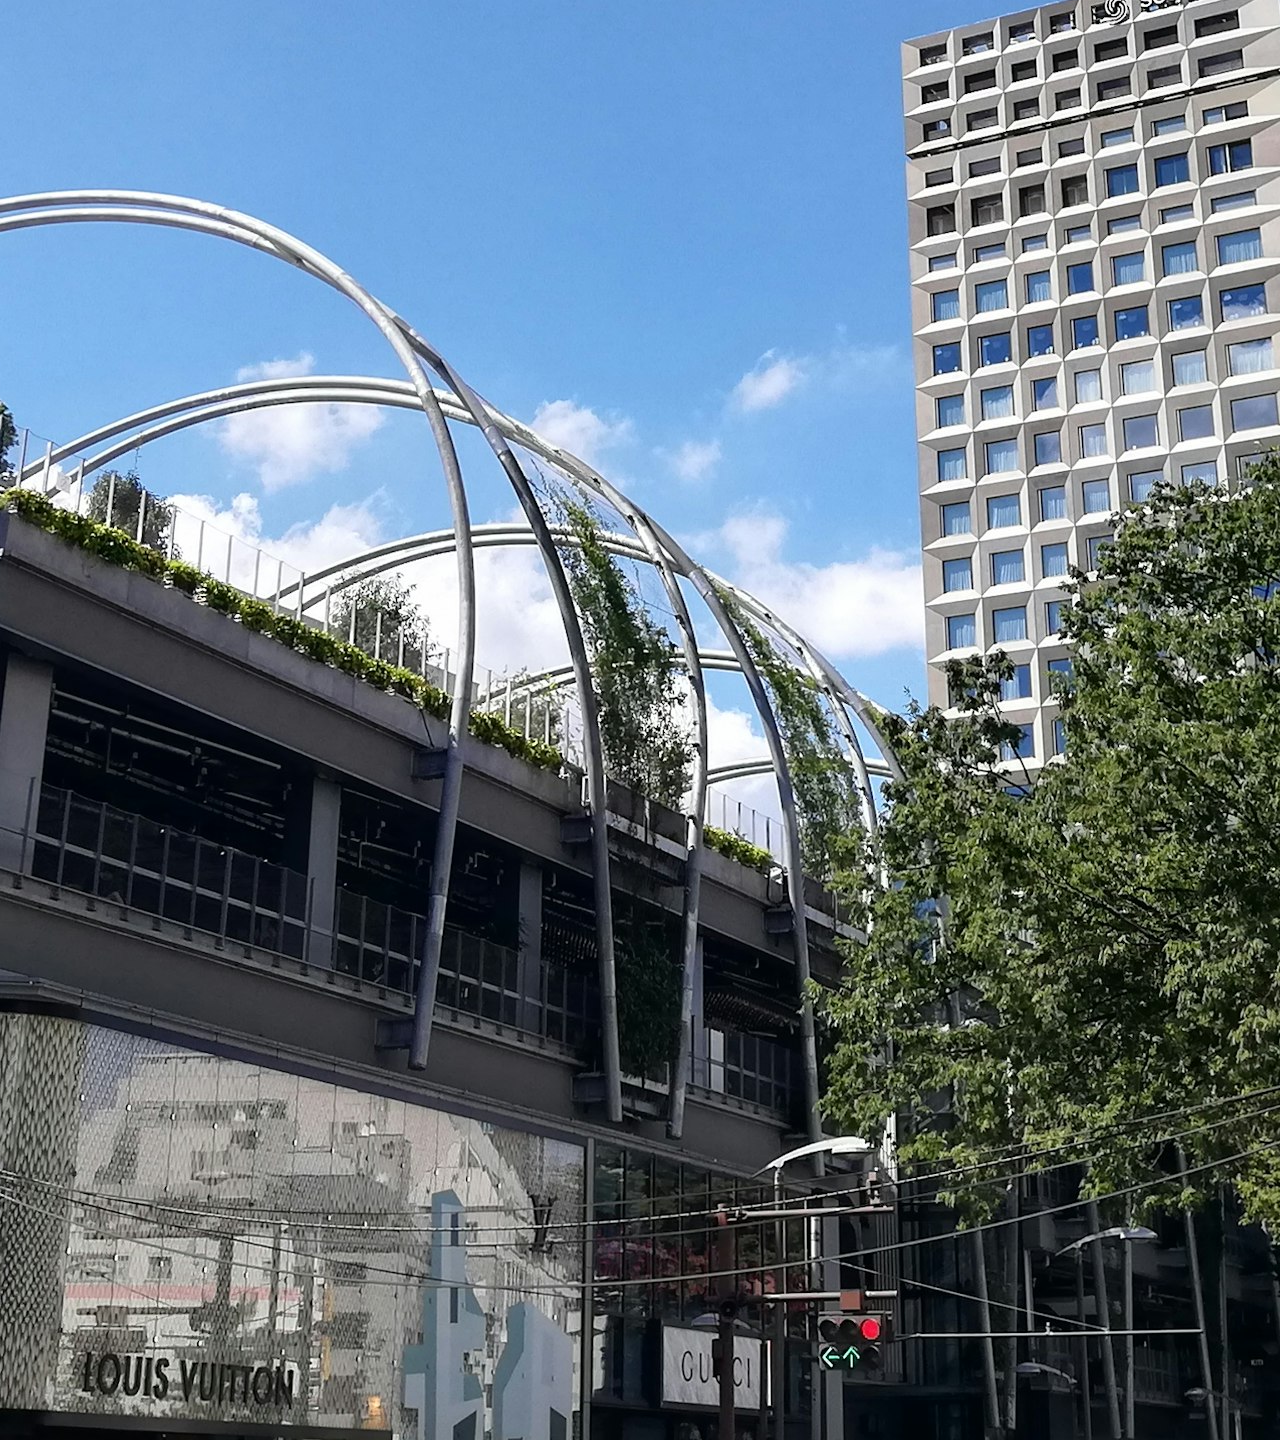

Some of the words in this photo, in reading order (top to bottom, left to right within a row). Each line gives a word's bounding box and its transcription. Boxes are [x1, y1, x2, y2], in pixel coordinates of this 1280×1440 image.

[82, 1352, 169, 1400] LOUIS
[178, 1359, 294, 1410] VUITTON
[682, 1350, 751, 1389] GUCI
